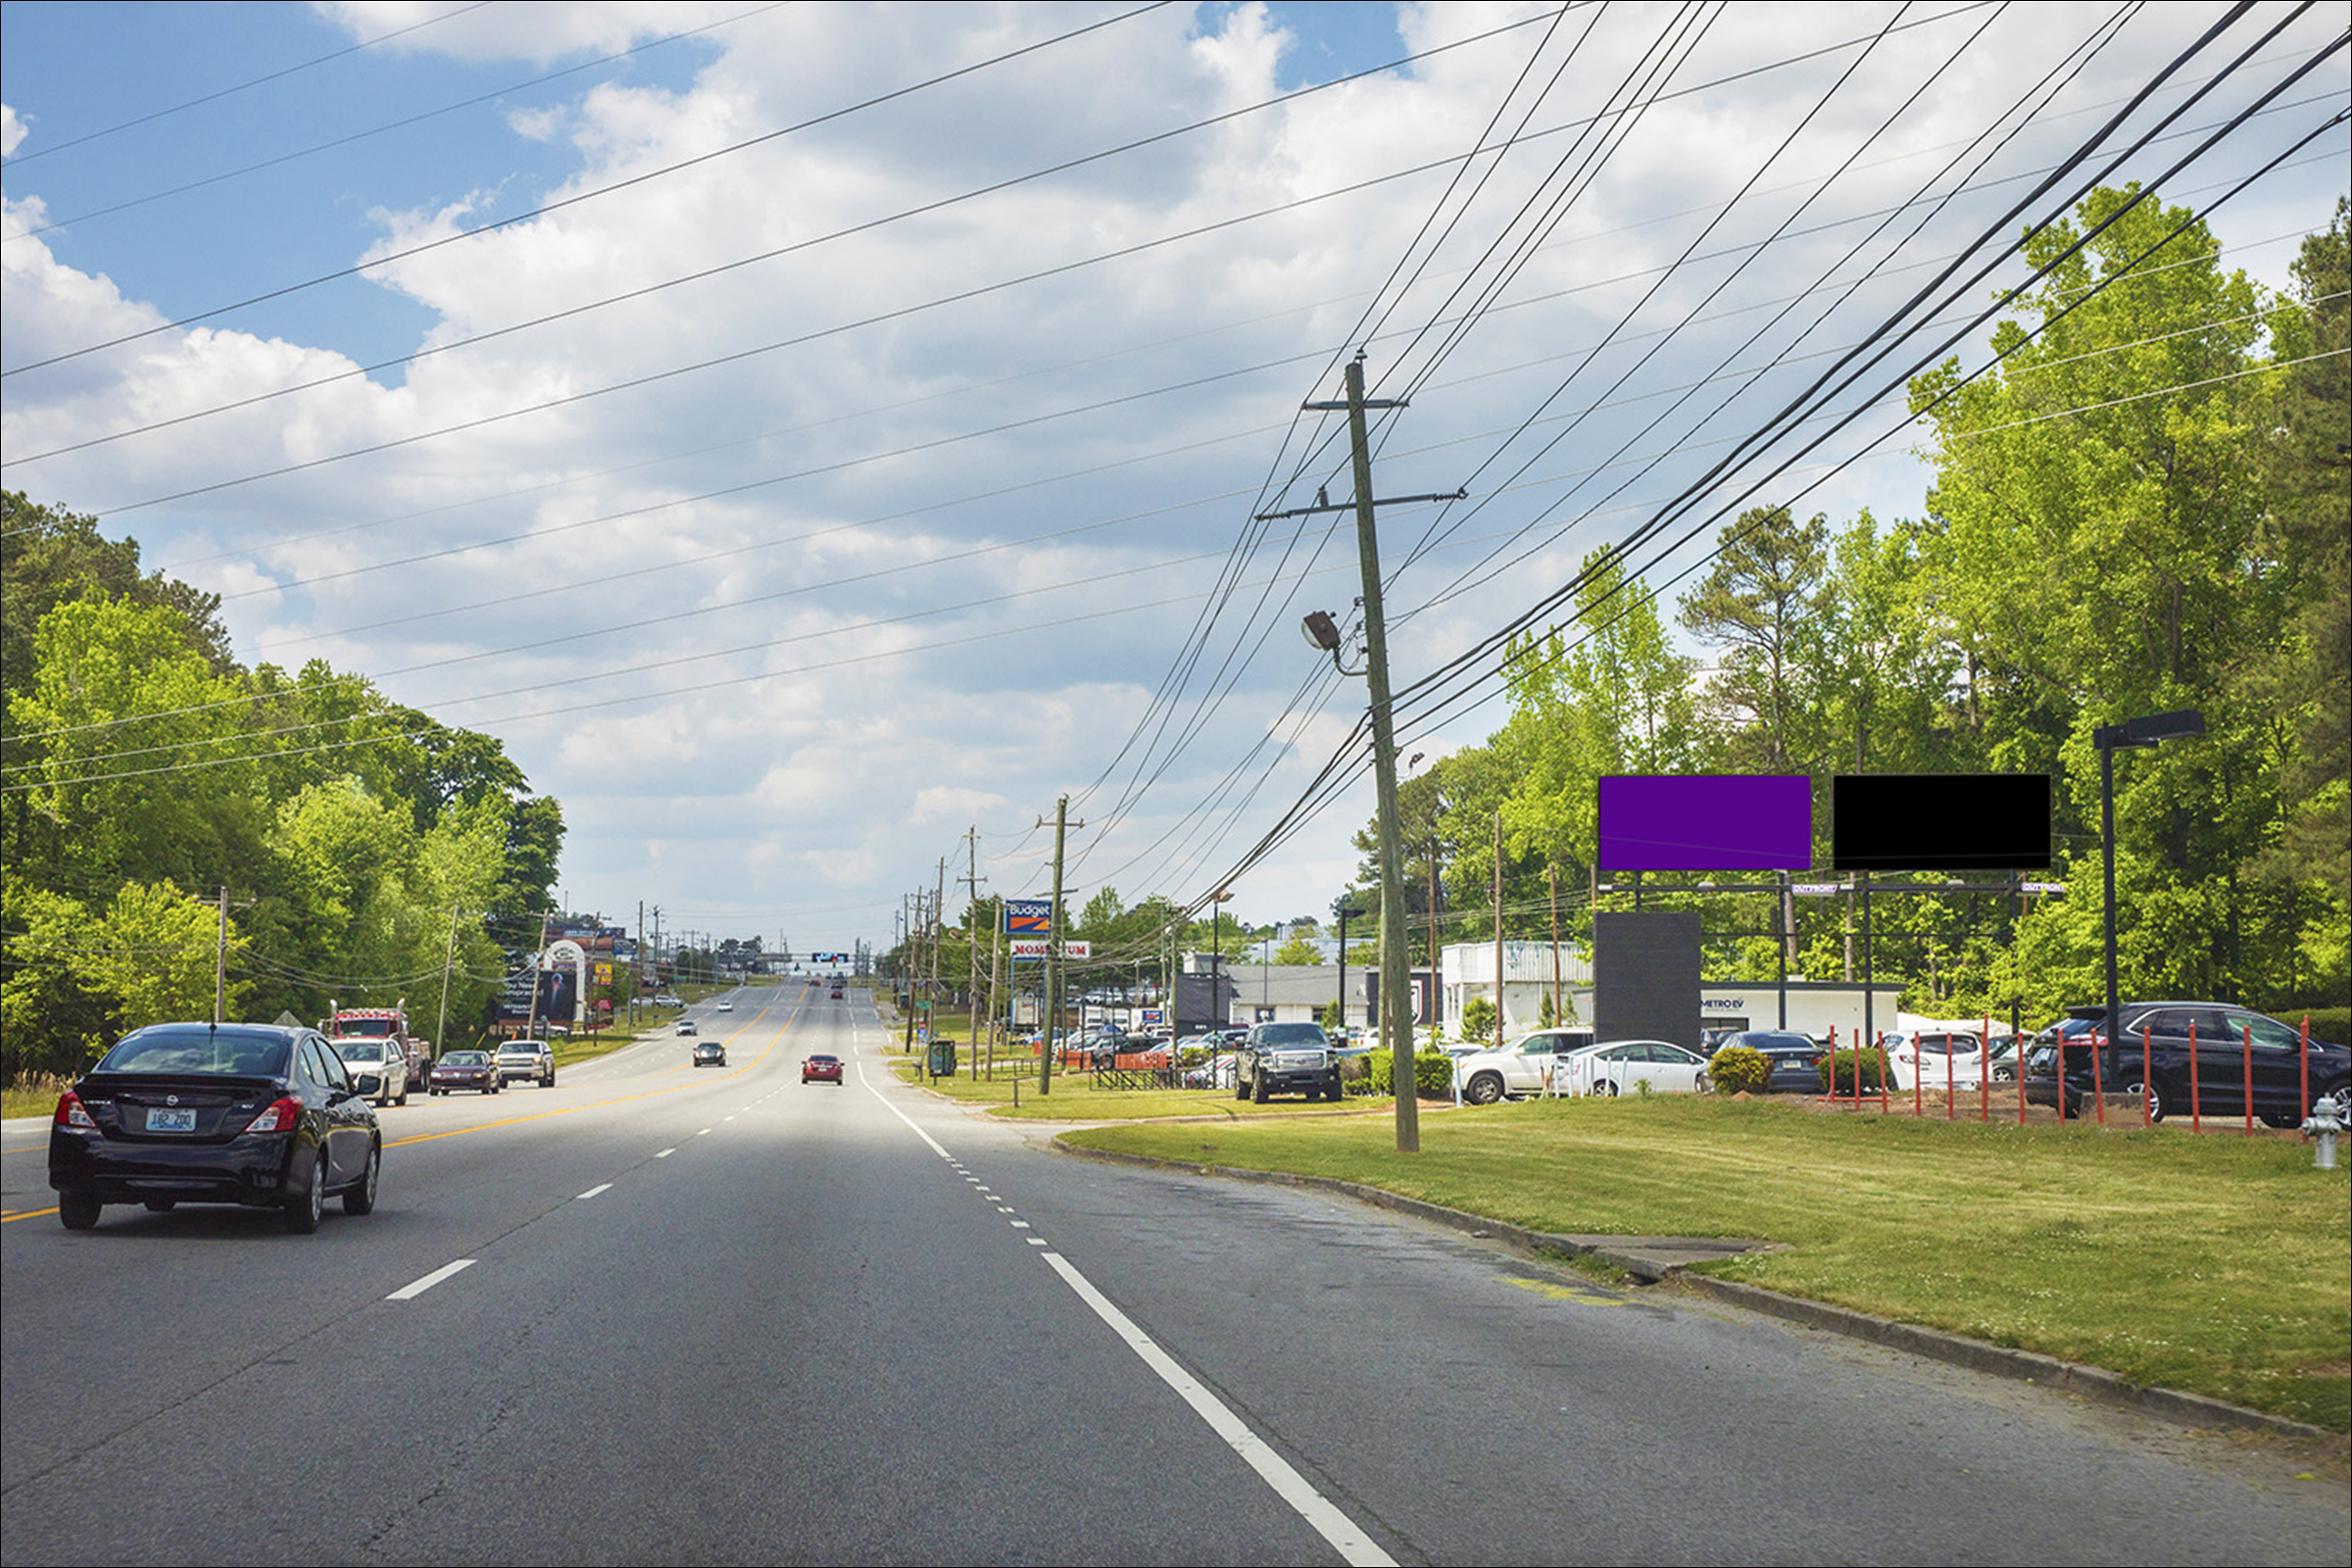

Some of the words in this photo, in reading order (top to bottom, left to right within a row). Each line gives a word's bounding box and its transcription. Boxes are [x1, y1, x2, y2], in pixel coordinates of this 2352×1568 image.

[1009, 904, 1050, 917] Budget
[1015, 944, 1086, 956] MOMUM
[1733, 1000, 1744, 1008] EV
